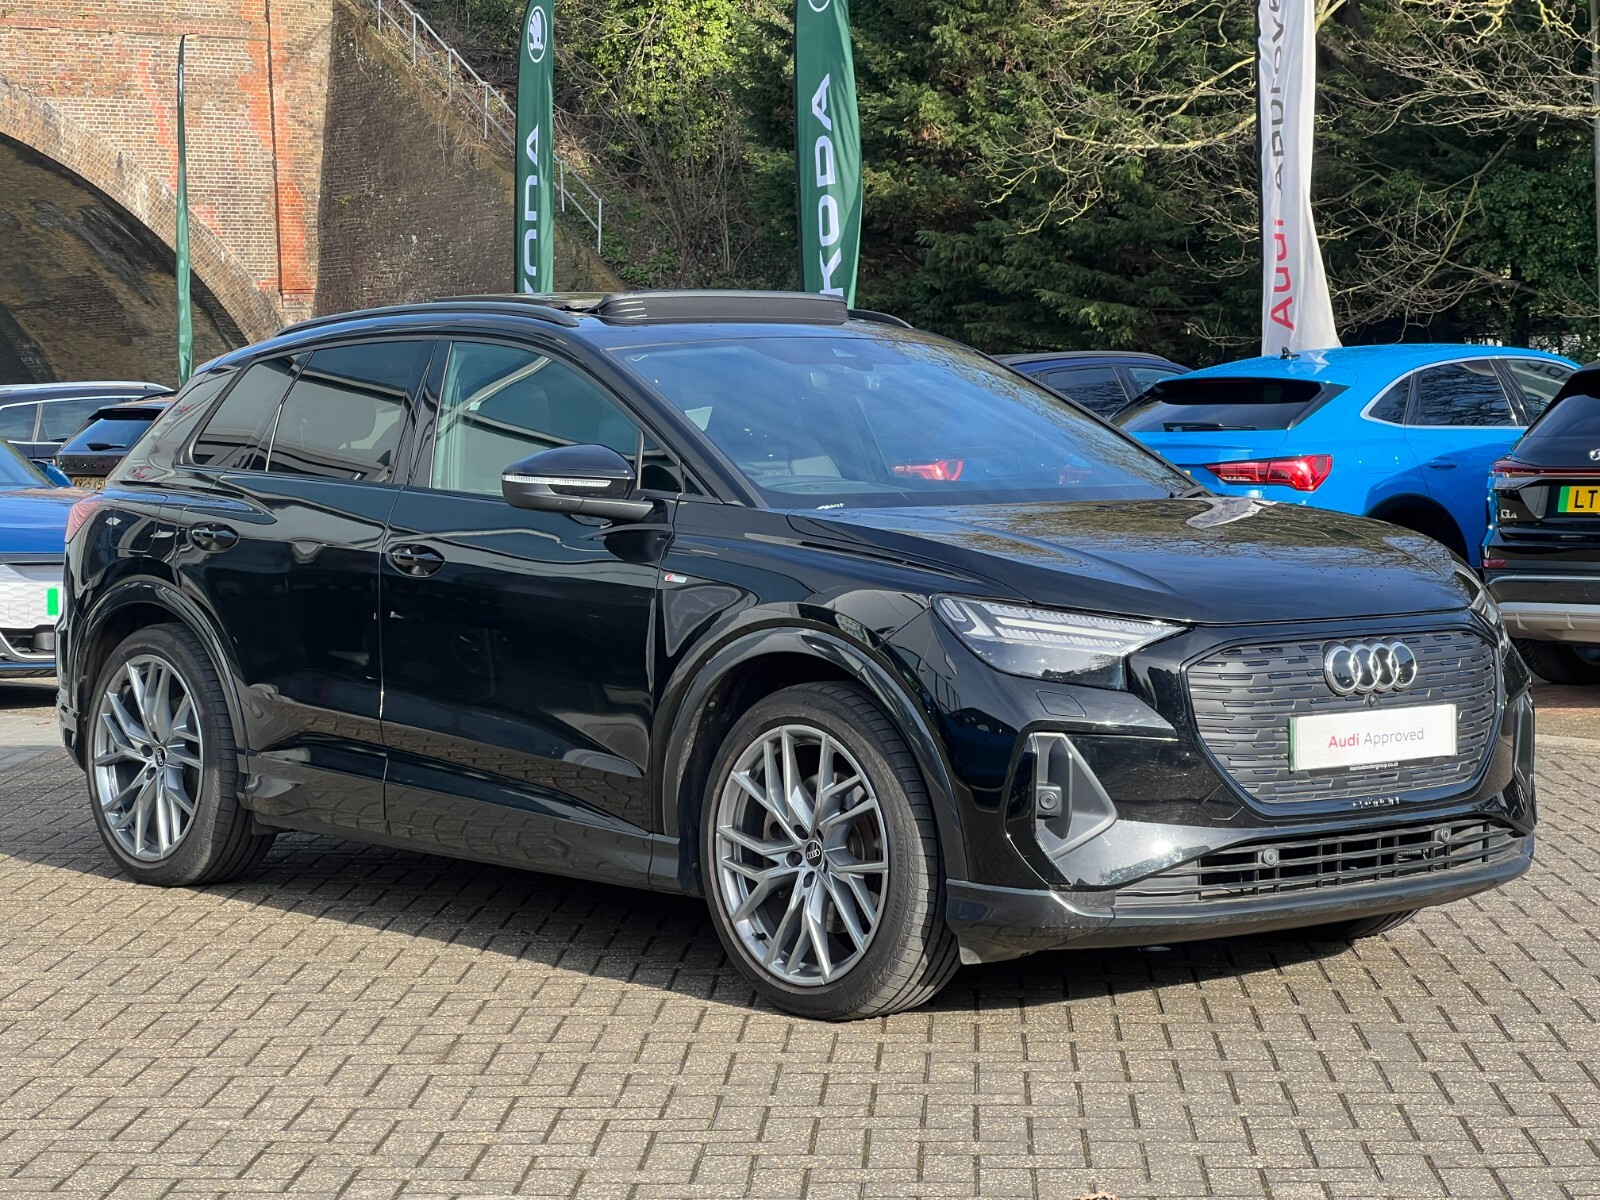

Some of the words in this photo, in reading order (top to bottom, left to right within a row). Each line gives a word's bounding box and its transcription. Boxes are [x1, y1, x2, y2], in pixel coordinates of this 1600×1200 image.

[1271, 219, 1295, 331] Audi
[1574, 490, 1598, 508] LT
[1501, 509, 1517, 519] Q4
[1328, 733, 1360, 748] Audi
[1364, 727, 1424, 747] Approved
